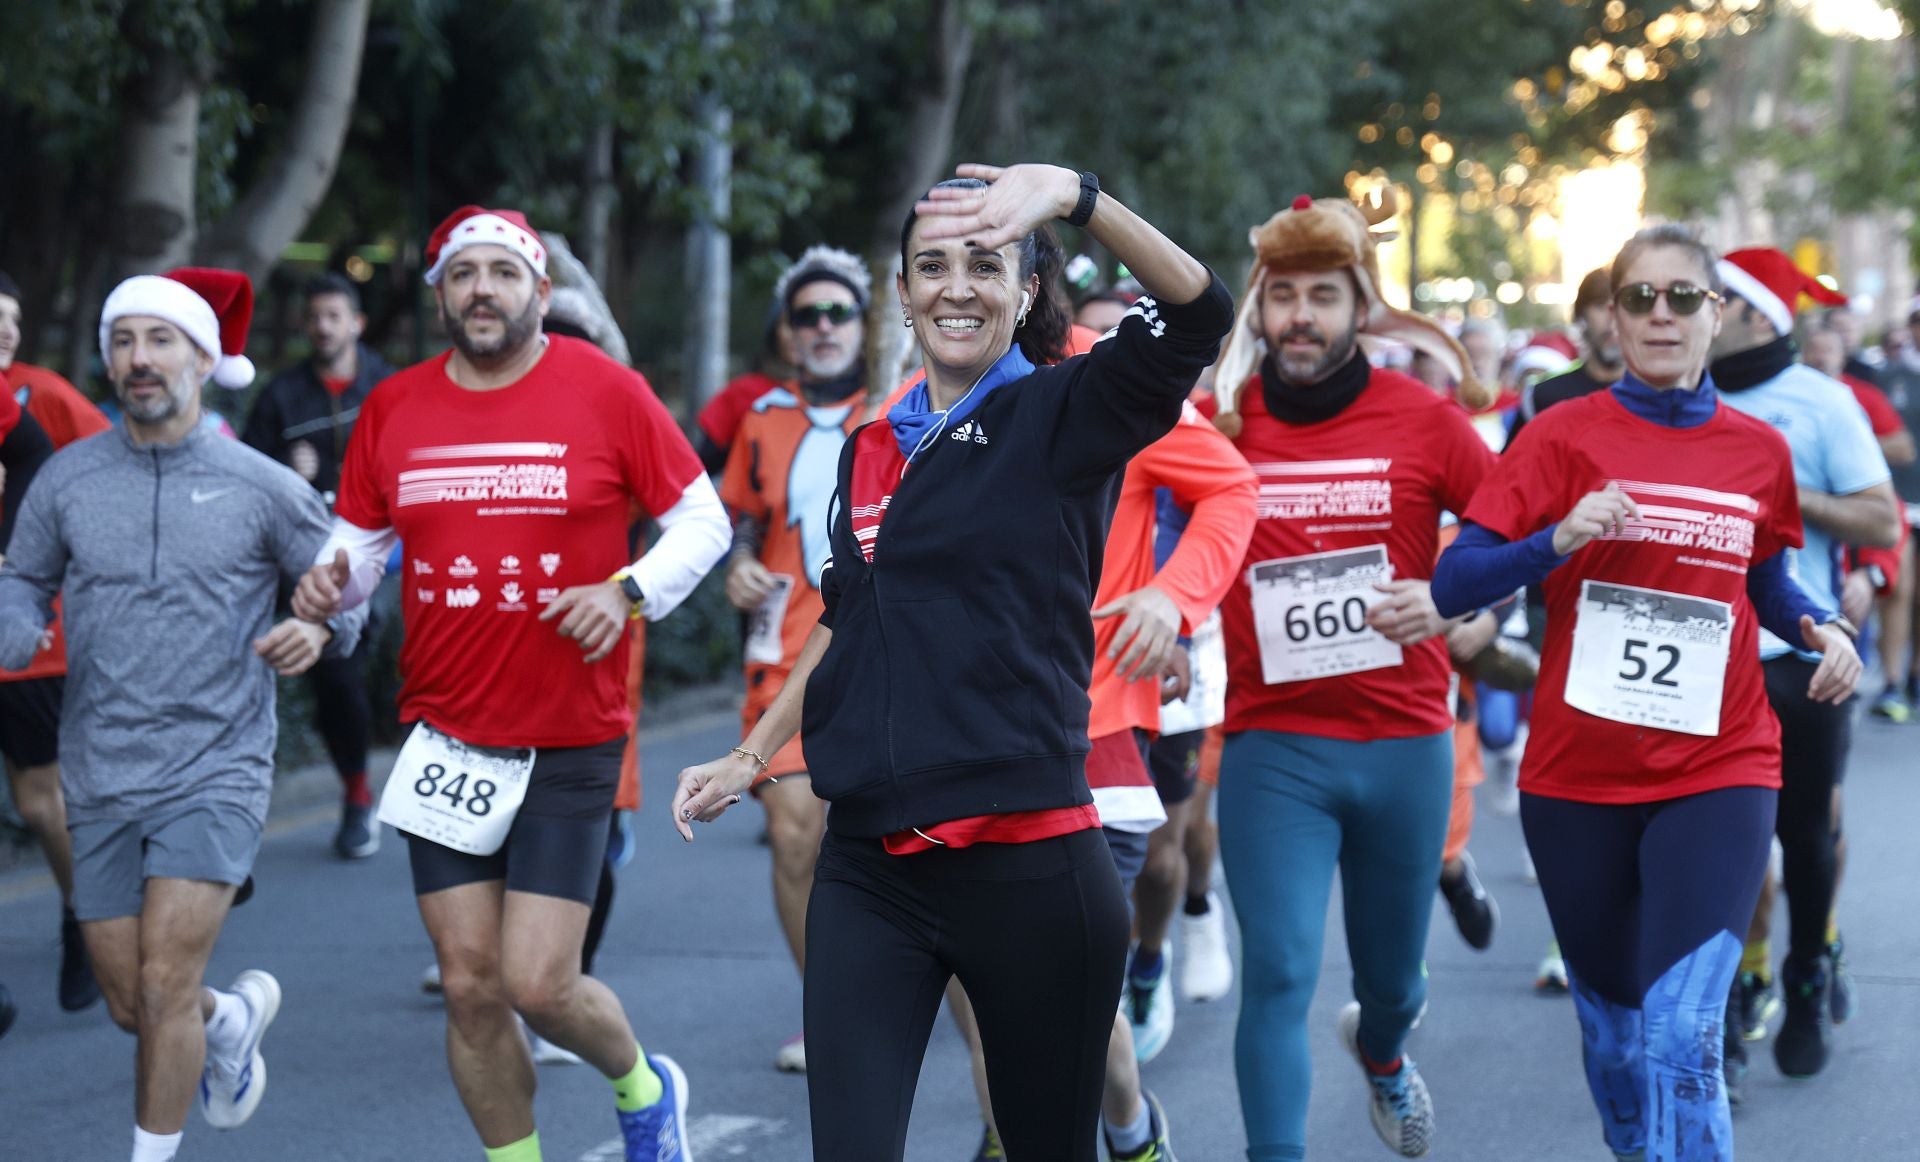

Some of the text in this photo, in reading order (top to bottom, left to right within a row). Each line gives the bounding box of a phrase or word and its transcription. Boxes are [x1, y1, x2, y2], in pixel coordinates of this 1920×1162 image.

[498, 464, 568, 479] CARRERA
[437, 486, 568, 502] PALMA PALMILLA
[1324, 479, 1392, 494] CARRERA
[1264, 501, 1392, 520] PALMA PALMILLA
[1679, 521, 1704, 534] SAN
[1641, 528, 1694, 547] PALMA
[1284, 596, 1367, 642] 660
[1618, 638, 1681, 688] 52
[414, 763, 497, 817] 848
